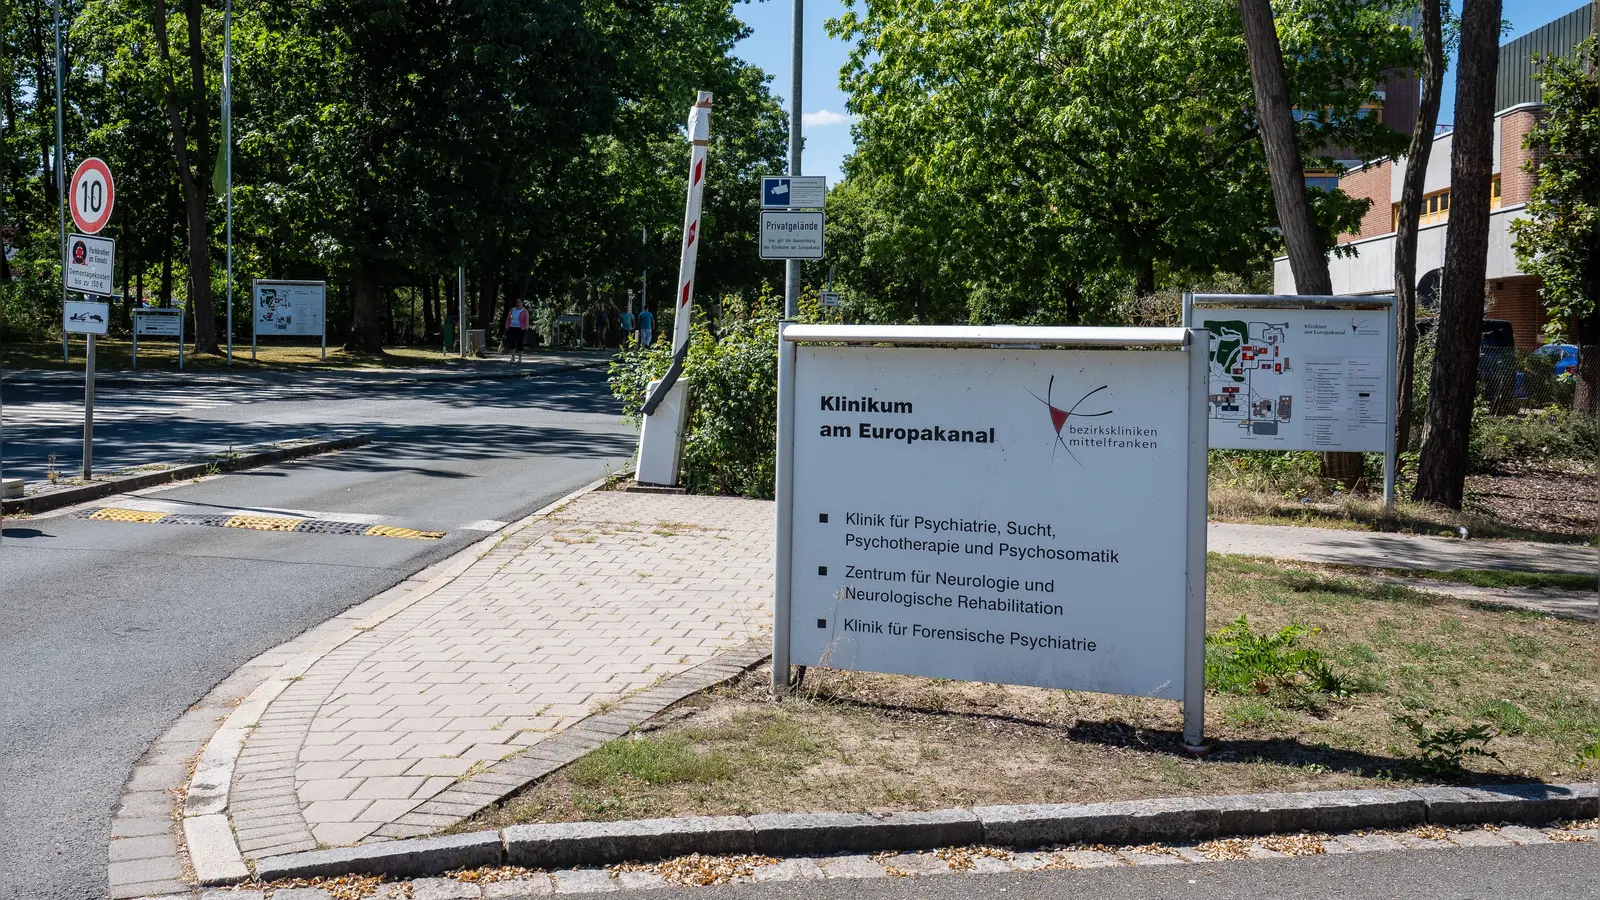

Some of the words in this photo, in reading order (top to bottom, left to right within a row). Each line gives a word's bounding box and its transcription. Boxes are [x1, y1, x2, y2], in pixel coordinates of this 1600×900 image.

[81, 180, 102, 213] 10
[766, 220, 819, 233] Privatgelände
[94, 255, 108, 265] Einsatz
[69, 267, 111, 281] Demontagekosten
[74, 277, 82, 285] bis
[820, 396, 913, 414] Klinikum
[819, 424, 852, 439] am
[858, 423, 996, 445] Europakanal
[1069, 424, 1158, 437] bezirkskliniken
[1069, 437, 1158, 449] mittelfranken
[845, 512, 886, 528] Klinik
[889, 514, 910, 529] für
[914, 516, 1002, 537] Psychiatrie,
[1006, 520, 1057, 540] Sucht,
[845, 533, 960, 556] Psychotherapie
[964, 541, 994, 556] und
[999, 543, 1120, 564] Psychosomatik
[845, 565, 907, 583] Zentrum
[910, 570, 932, 584] für
[935, 571, 1020, 593] Neurologie
[1024, 579, 1055, 593] und
[845, 587, 953, 608] Neurologische
[957, 594, 1064, 616] Rehabilitation
[843, 618, 884, 635] Klinik
[887, 622, 909, 637] für
[912, 624, 1006, 645] Forensische
[1009, 632, 1098, 653] Psychiatrie
